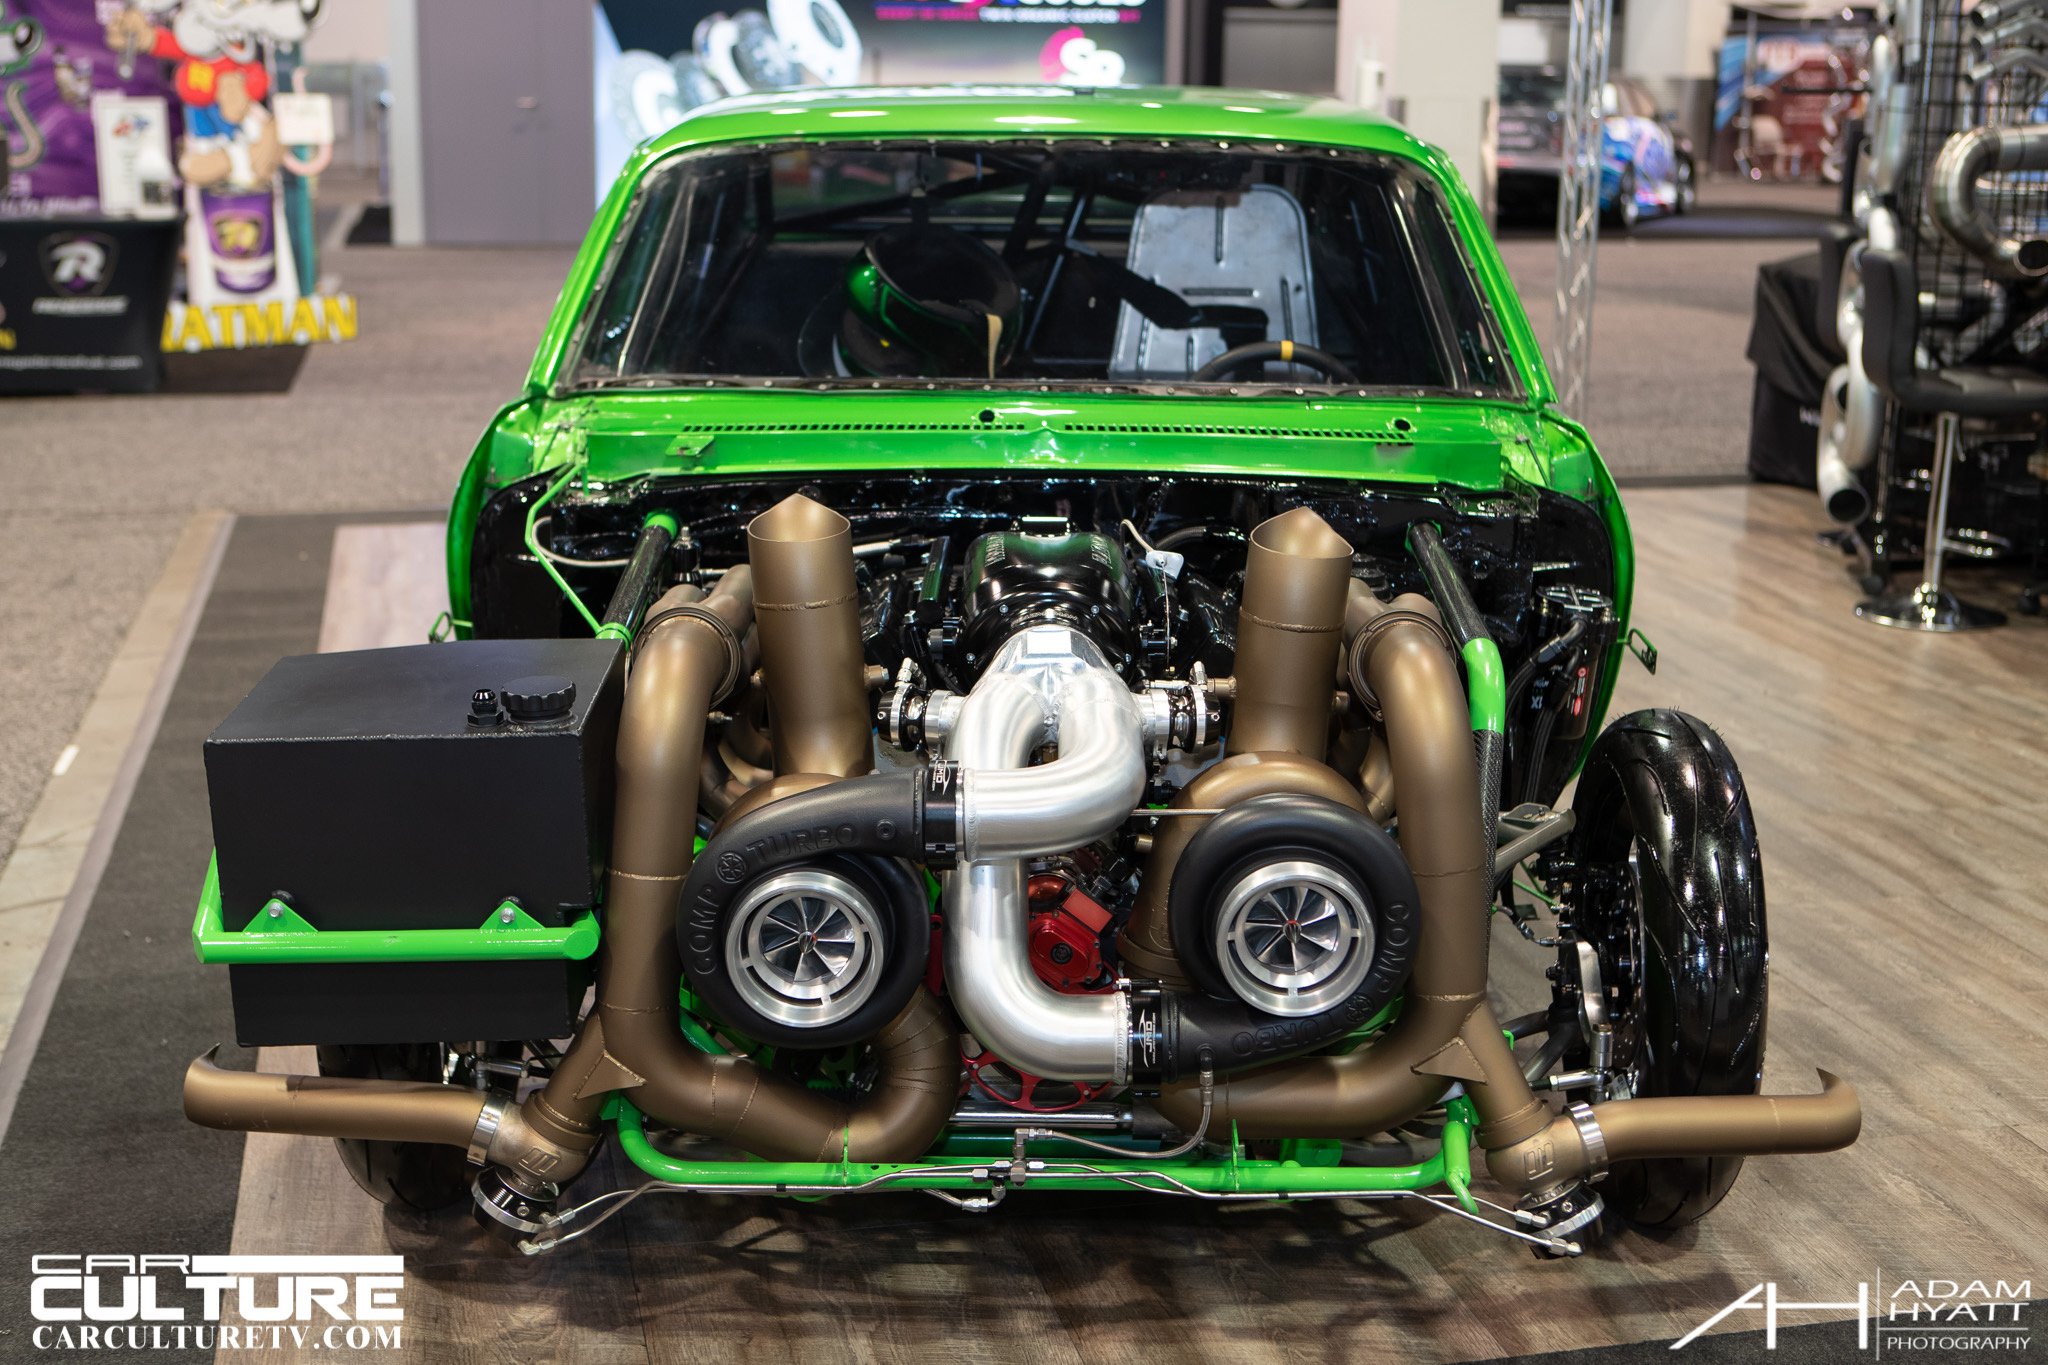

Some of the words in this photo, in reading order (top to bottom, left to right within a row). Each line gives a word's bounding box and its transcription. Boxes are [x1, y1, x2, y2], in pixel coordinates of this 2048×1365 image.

[687, 885, 720, 976] COMP
[745, 822, 859, 865] TURBO
[1374, 902, 1411, 994] COMP
[1231, 1012, 1344, 1057] TURBO
